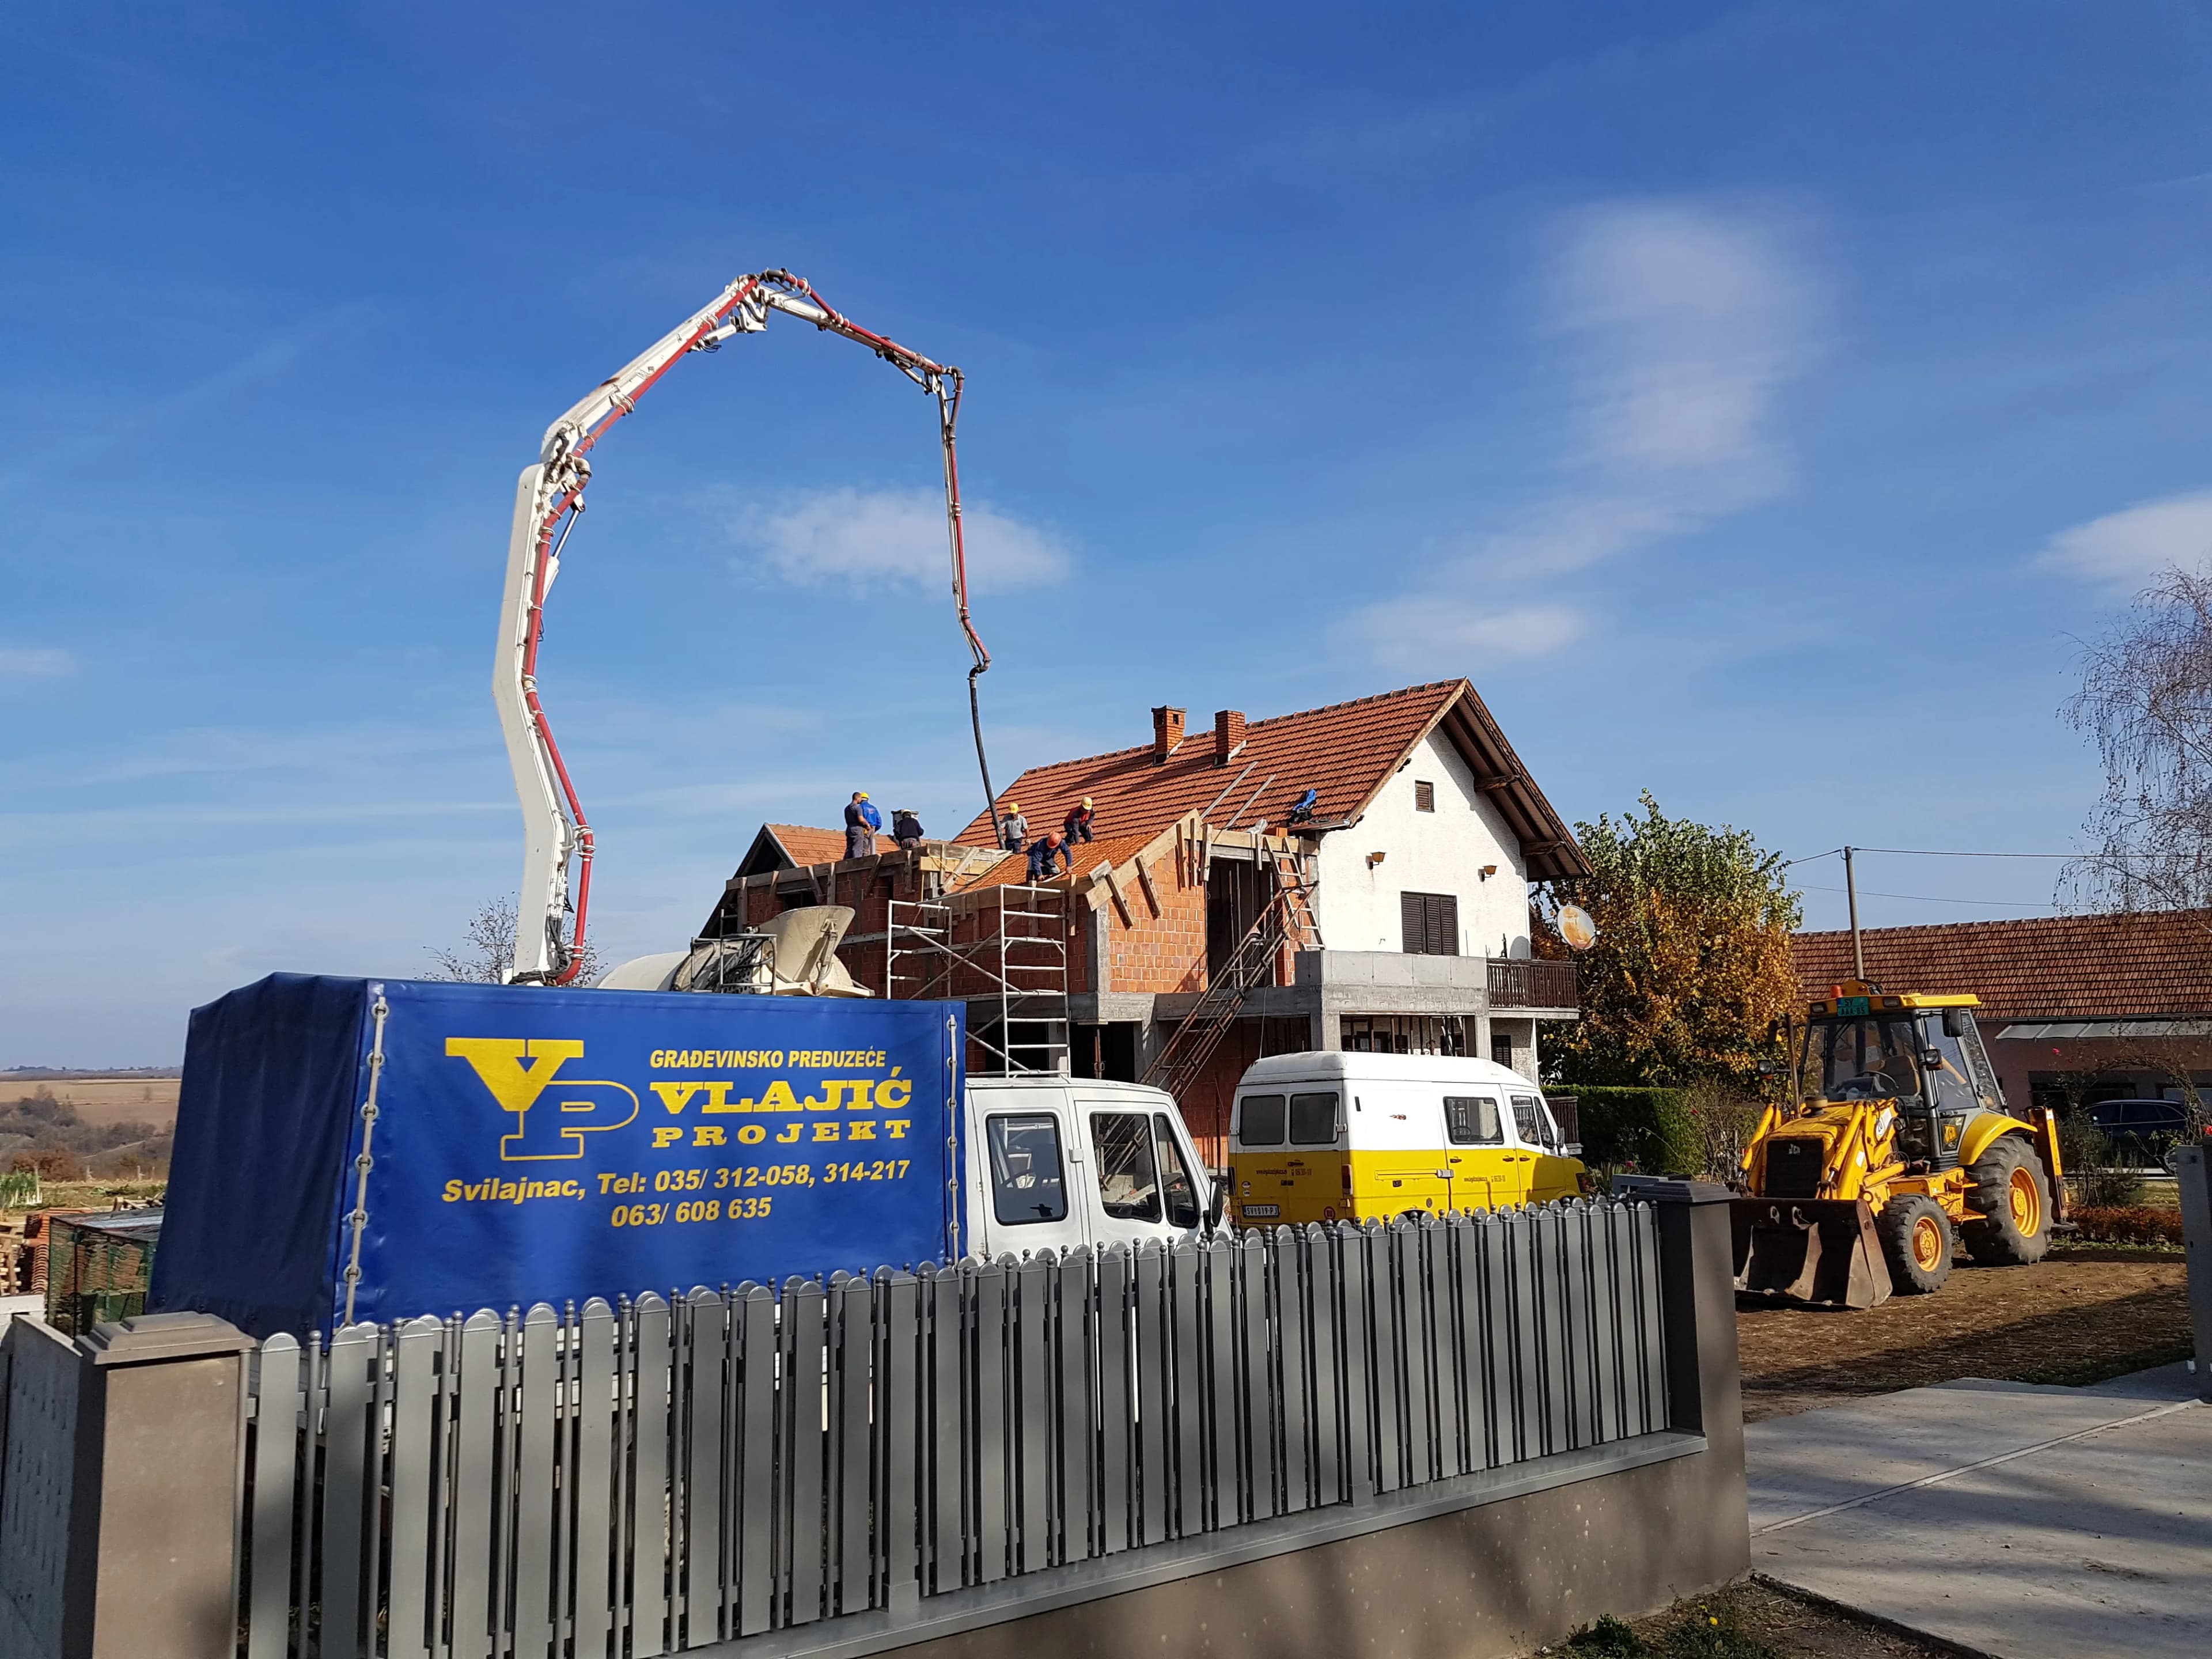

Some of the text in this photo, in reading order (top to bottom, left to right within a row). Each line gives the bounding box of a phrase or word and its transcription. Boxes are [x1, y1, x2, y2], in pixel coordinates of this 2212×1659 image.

[650, 1045, 886, 1069] GRAĐEVINSKO PREDUZEĆE
[649, 1066, 912, 1115] VLAJIĆ
[652, 1119, 911, 1148] PROJEKT
[442, 1160, 910, 1205] Svilajnac, Tel: 035/ 312-058, 314-217
[611, 1197, 772, 1228] 063/ 608 635
